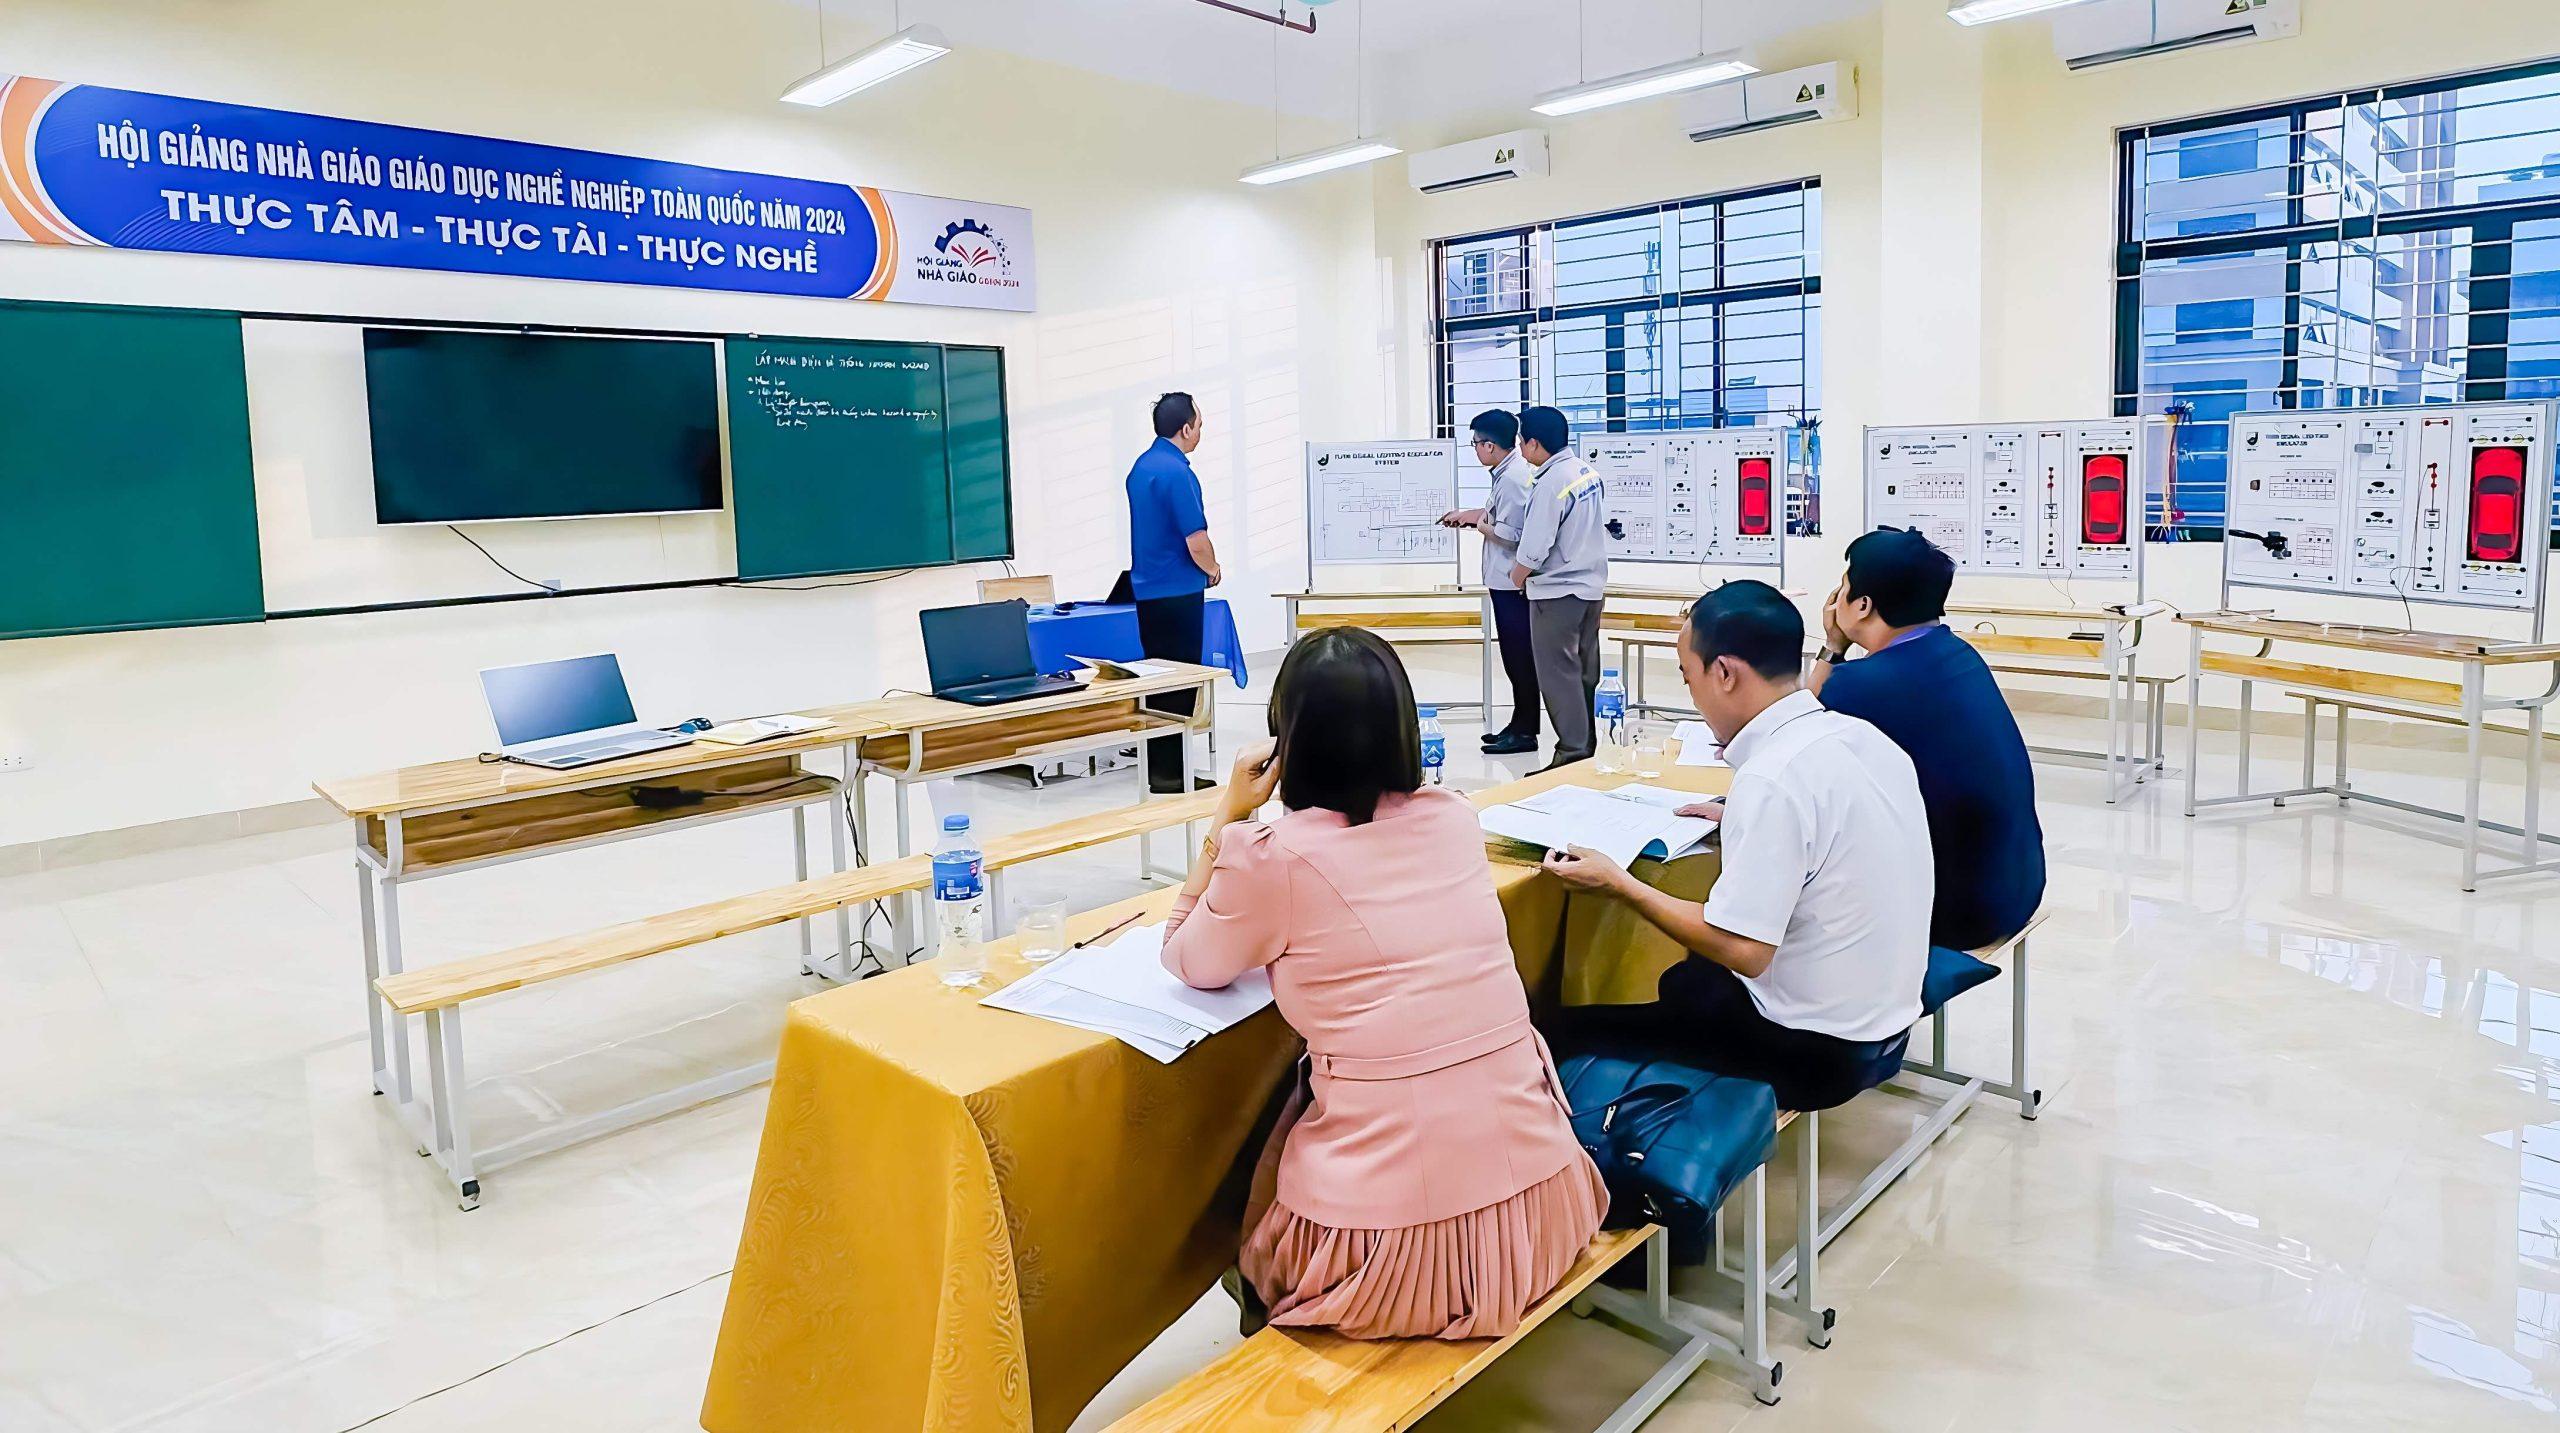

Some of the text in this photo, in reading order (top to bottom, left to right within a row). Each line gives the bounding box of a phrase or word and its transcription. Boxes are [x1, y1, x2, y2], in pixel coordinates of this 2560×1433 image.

[97, 119, 846, 236] HỘI GIẢNG NHÀ GIÁO GIÁO DỤC NGHỀ NGHIỆP TOÀN QUỐC NĂM 2024
[160, 189, 293, 235] THỰC
[306, 198, 399, 239] TÂM
[435, 215, 541, 255] THỰC
[552, 221, 607, 256] TÀI
[637, 235, 726, 271] THỰC
[736, 238, 818, 274] NGHỀ
